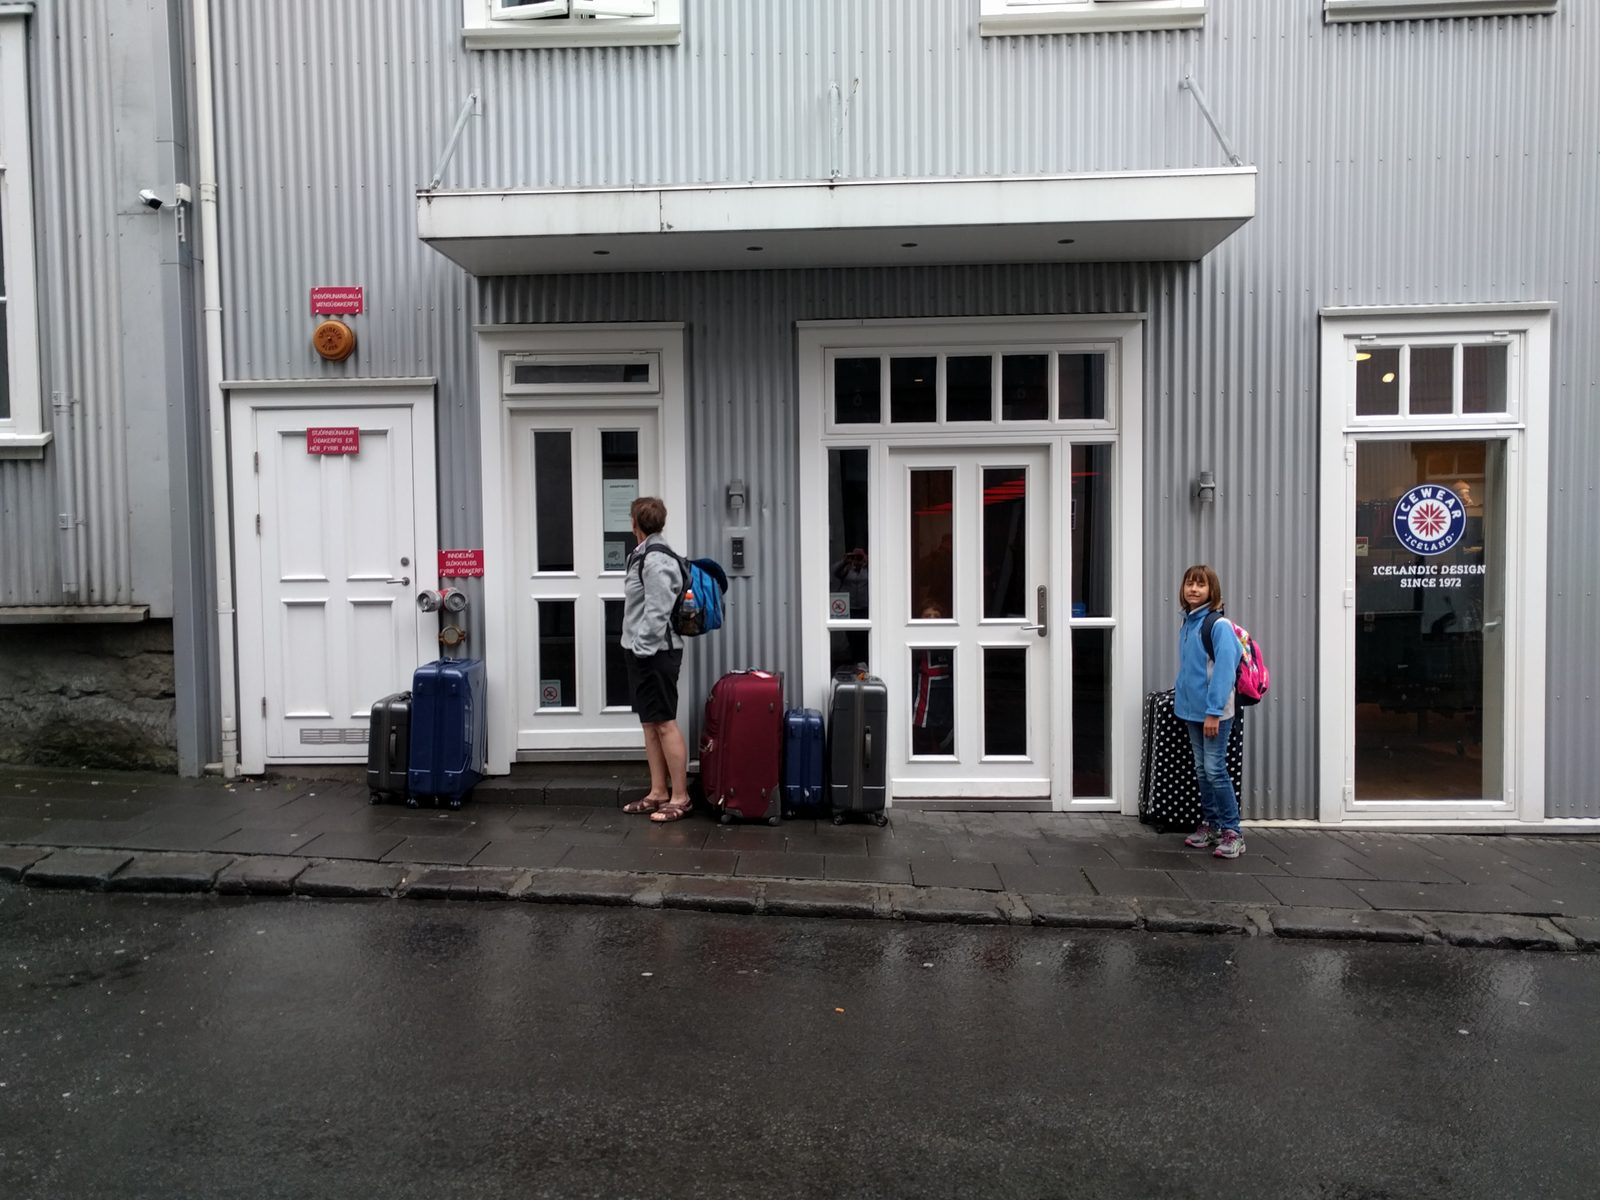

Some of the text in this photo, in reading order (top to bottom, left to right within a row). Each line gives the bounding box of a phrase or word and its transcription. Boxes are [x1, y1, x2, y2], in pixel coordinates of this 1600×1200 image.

[1397, 487, 1462, 521] ICEWEAR
[1406, 536, 1453, 551] ICELAND
[1372, 564, 1486, 575] ICELANDIC DESIGN
[1400, 578, 1462, 588] SINCE 1972
